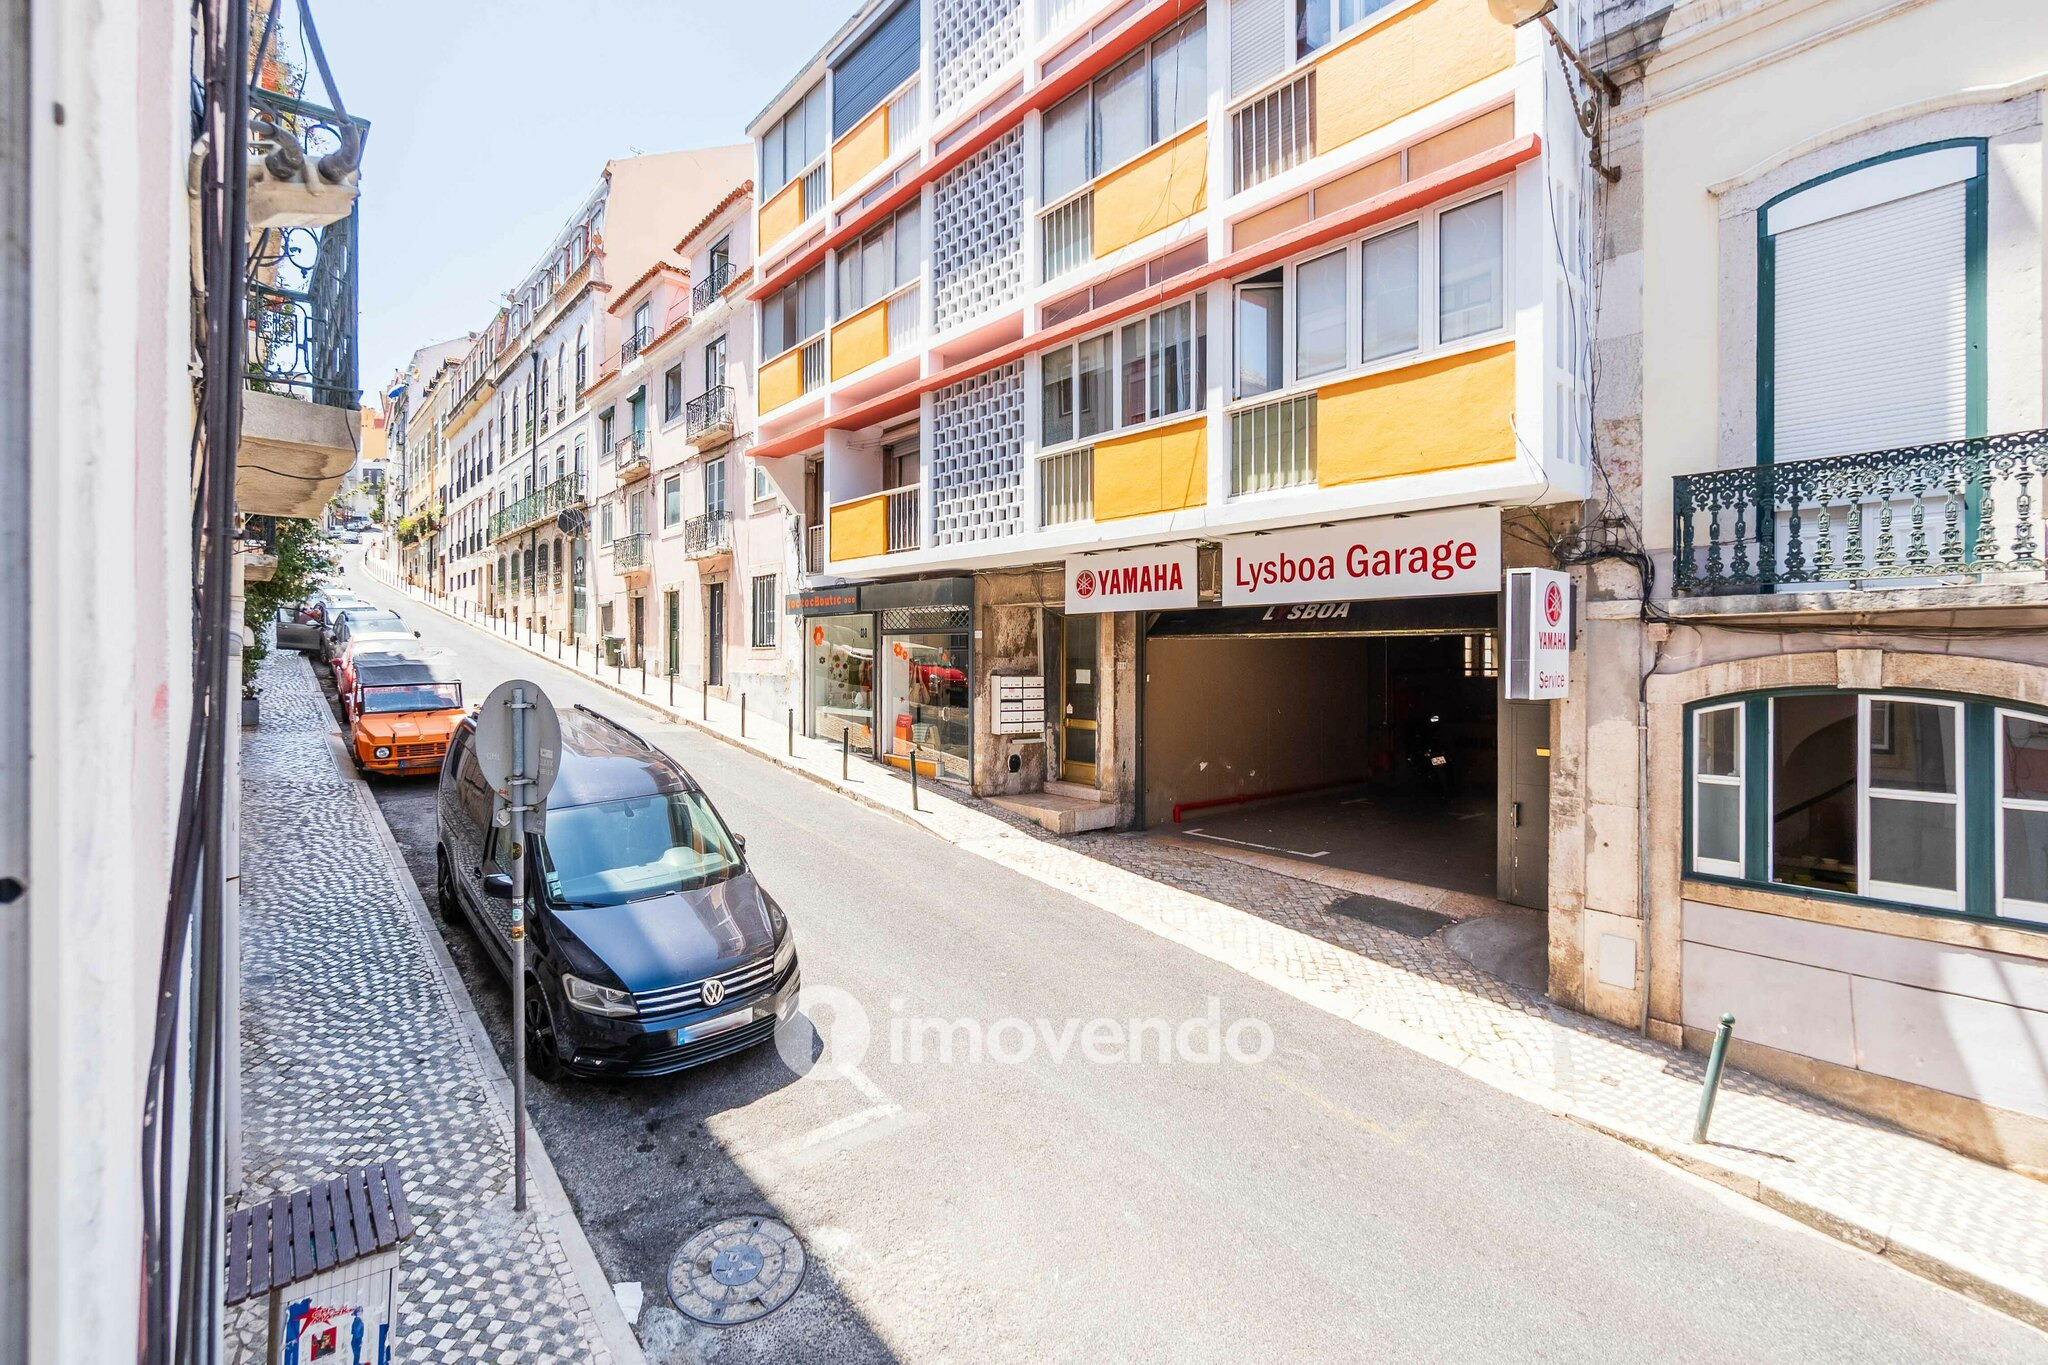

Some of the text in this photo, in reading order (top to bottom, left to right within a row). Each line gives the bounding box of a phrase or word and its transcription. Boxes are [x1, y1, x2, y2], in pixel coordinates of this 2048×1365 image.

[1098, 562, 1183, 596] YAMAHA
[1236, 540, 1477, 594] Lysboa Garage
[1539, 631, 1567, 650] YAMAHA
[1539, 671, 1565, 689] Service
